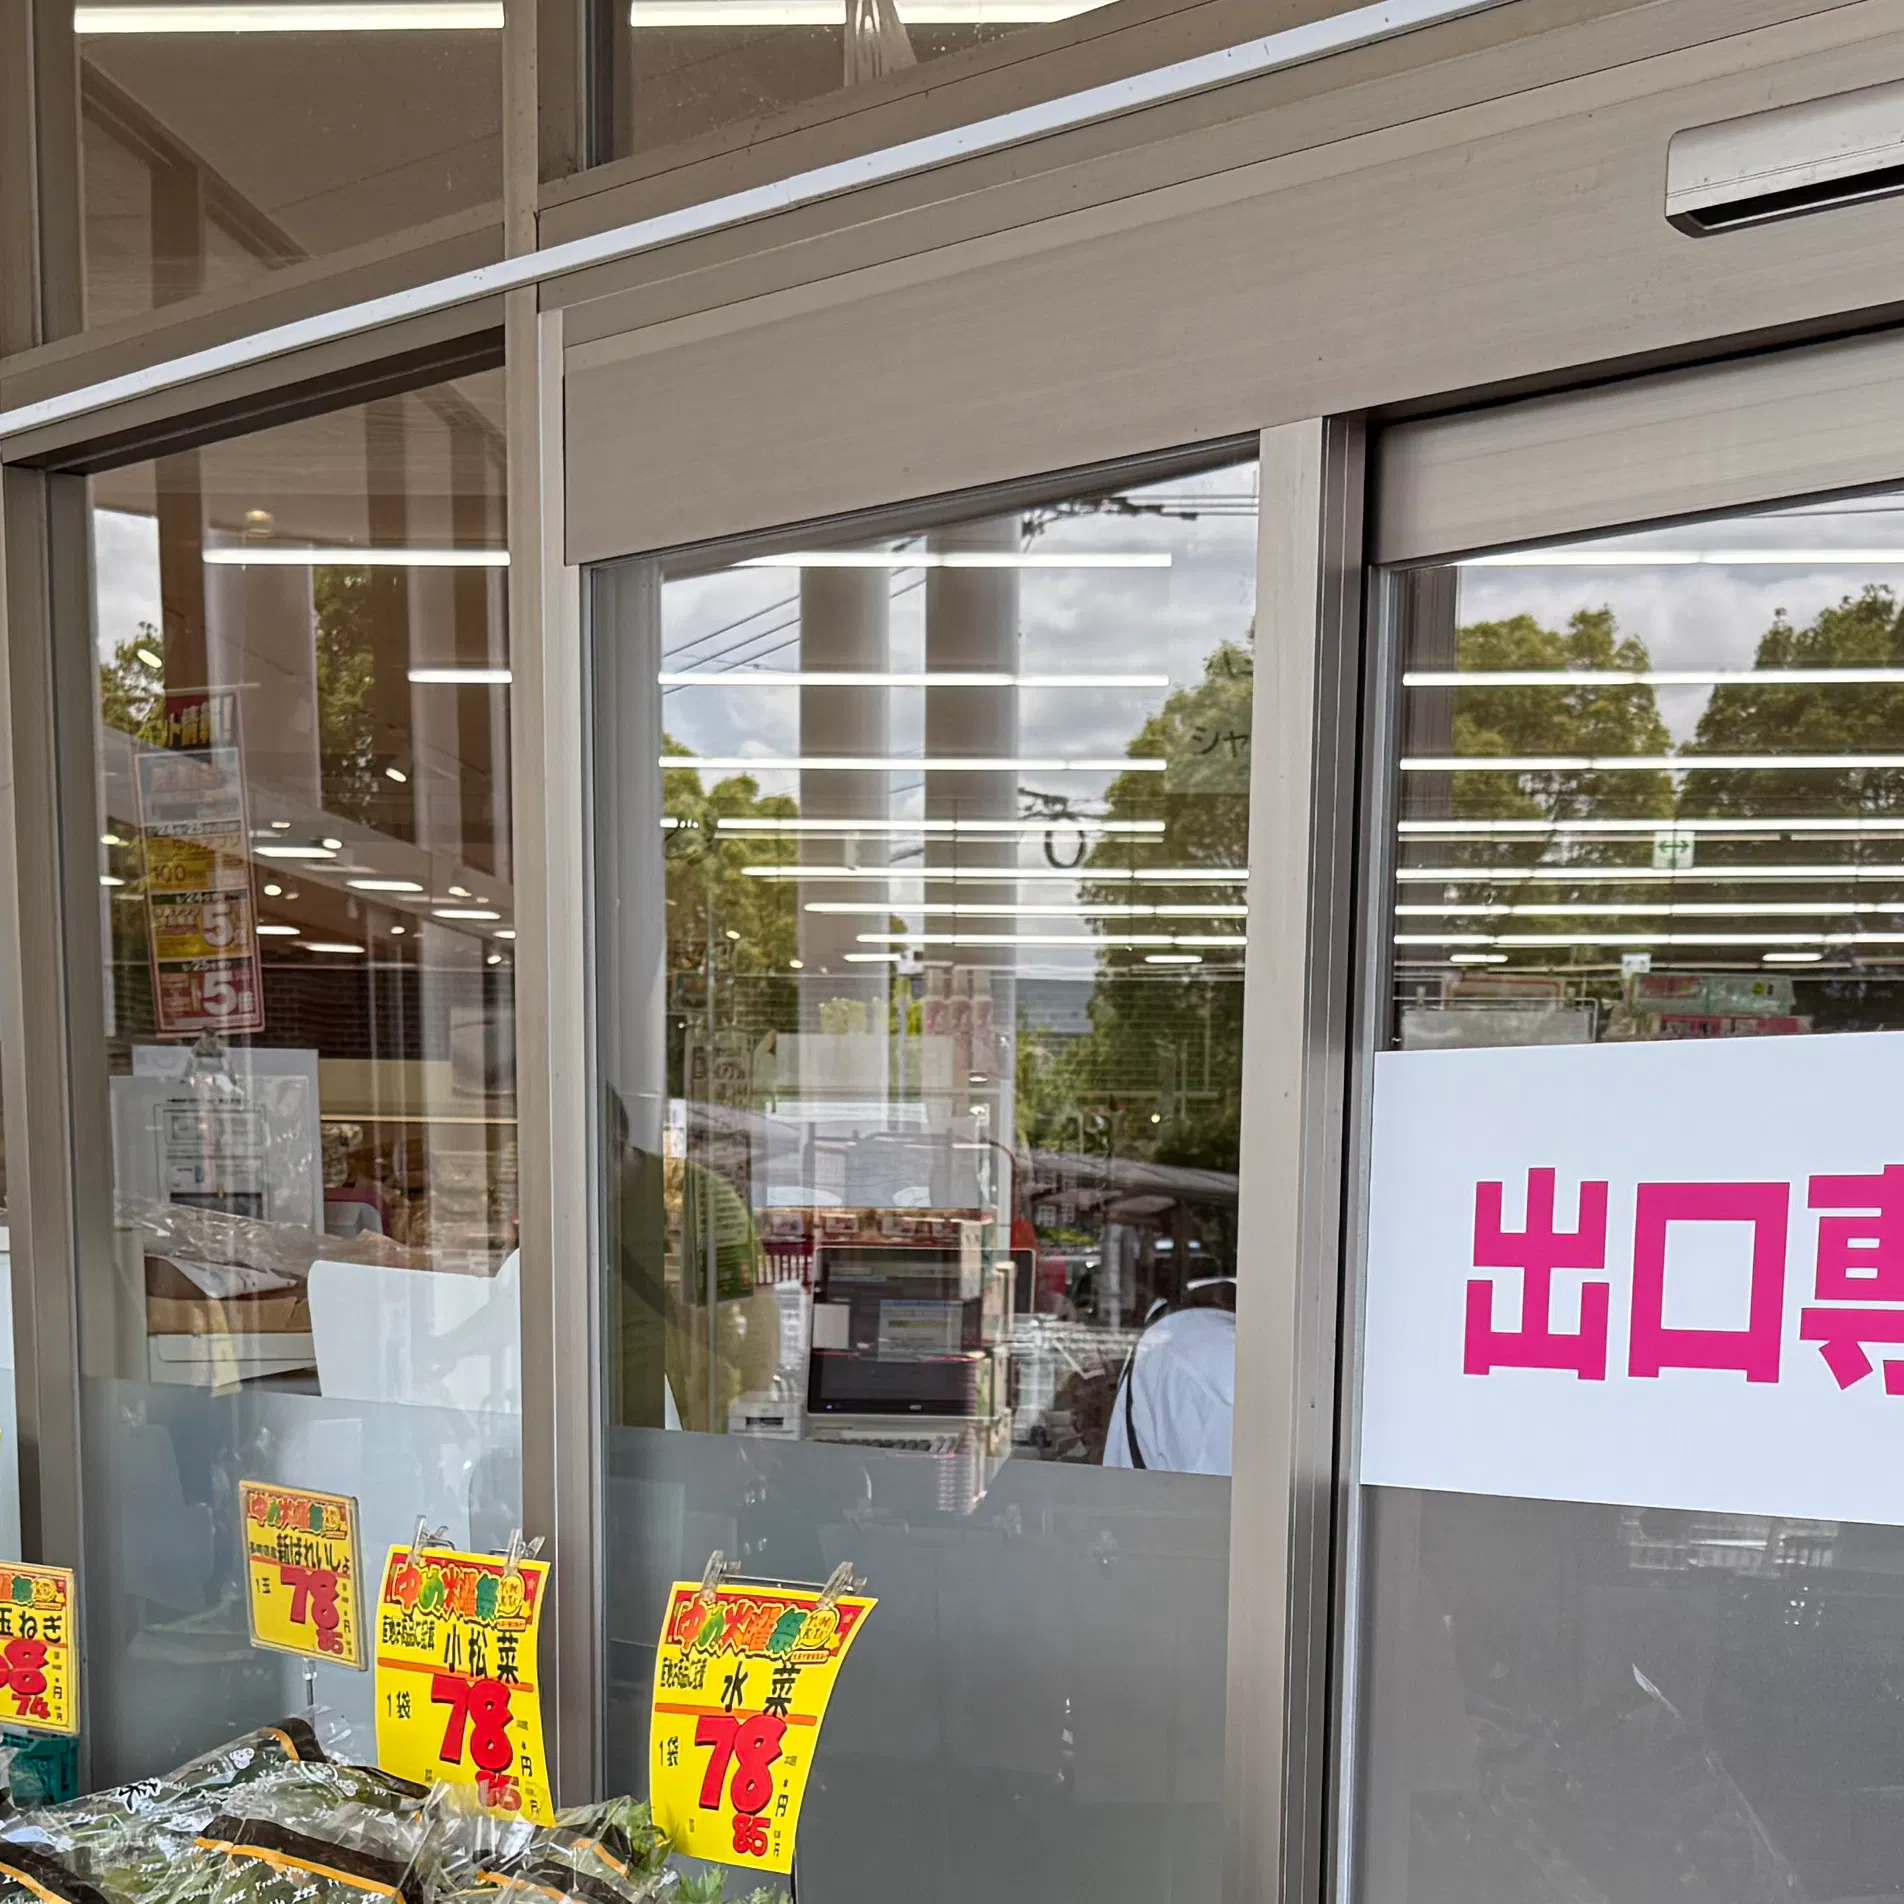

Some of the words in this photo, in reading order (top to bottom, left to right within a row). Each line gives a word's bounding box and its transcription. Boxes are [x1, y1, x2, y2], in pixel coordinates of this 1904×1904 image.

[280, 1567, 339, 1630] 78
[443, 1623, 519, 1684] 小松菜
[12, 1694, 50, 1719] 74
[387, 1690, 411, 1719] 1袋
[721, 1660, 801, 1718] 水菜
[431, 1673, 514, 1773] 78
[659, 1736, 679, 1766] 1袋
[695, 1715, 787, 1816] 78
[732, 1812, 771, 1857] 85
